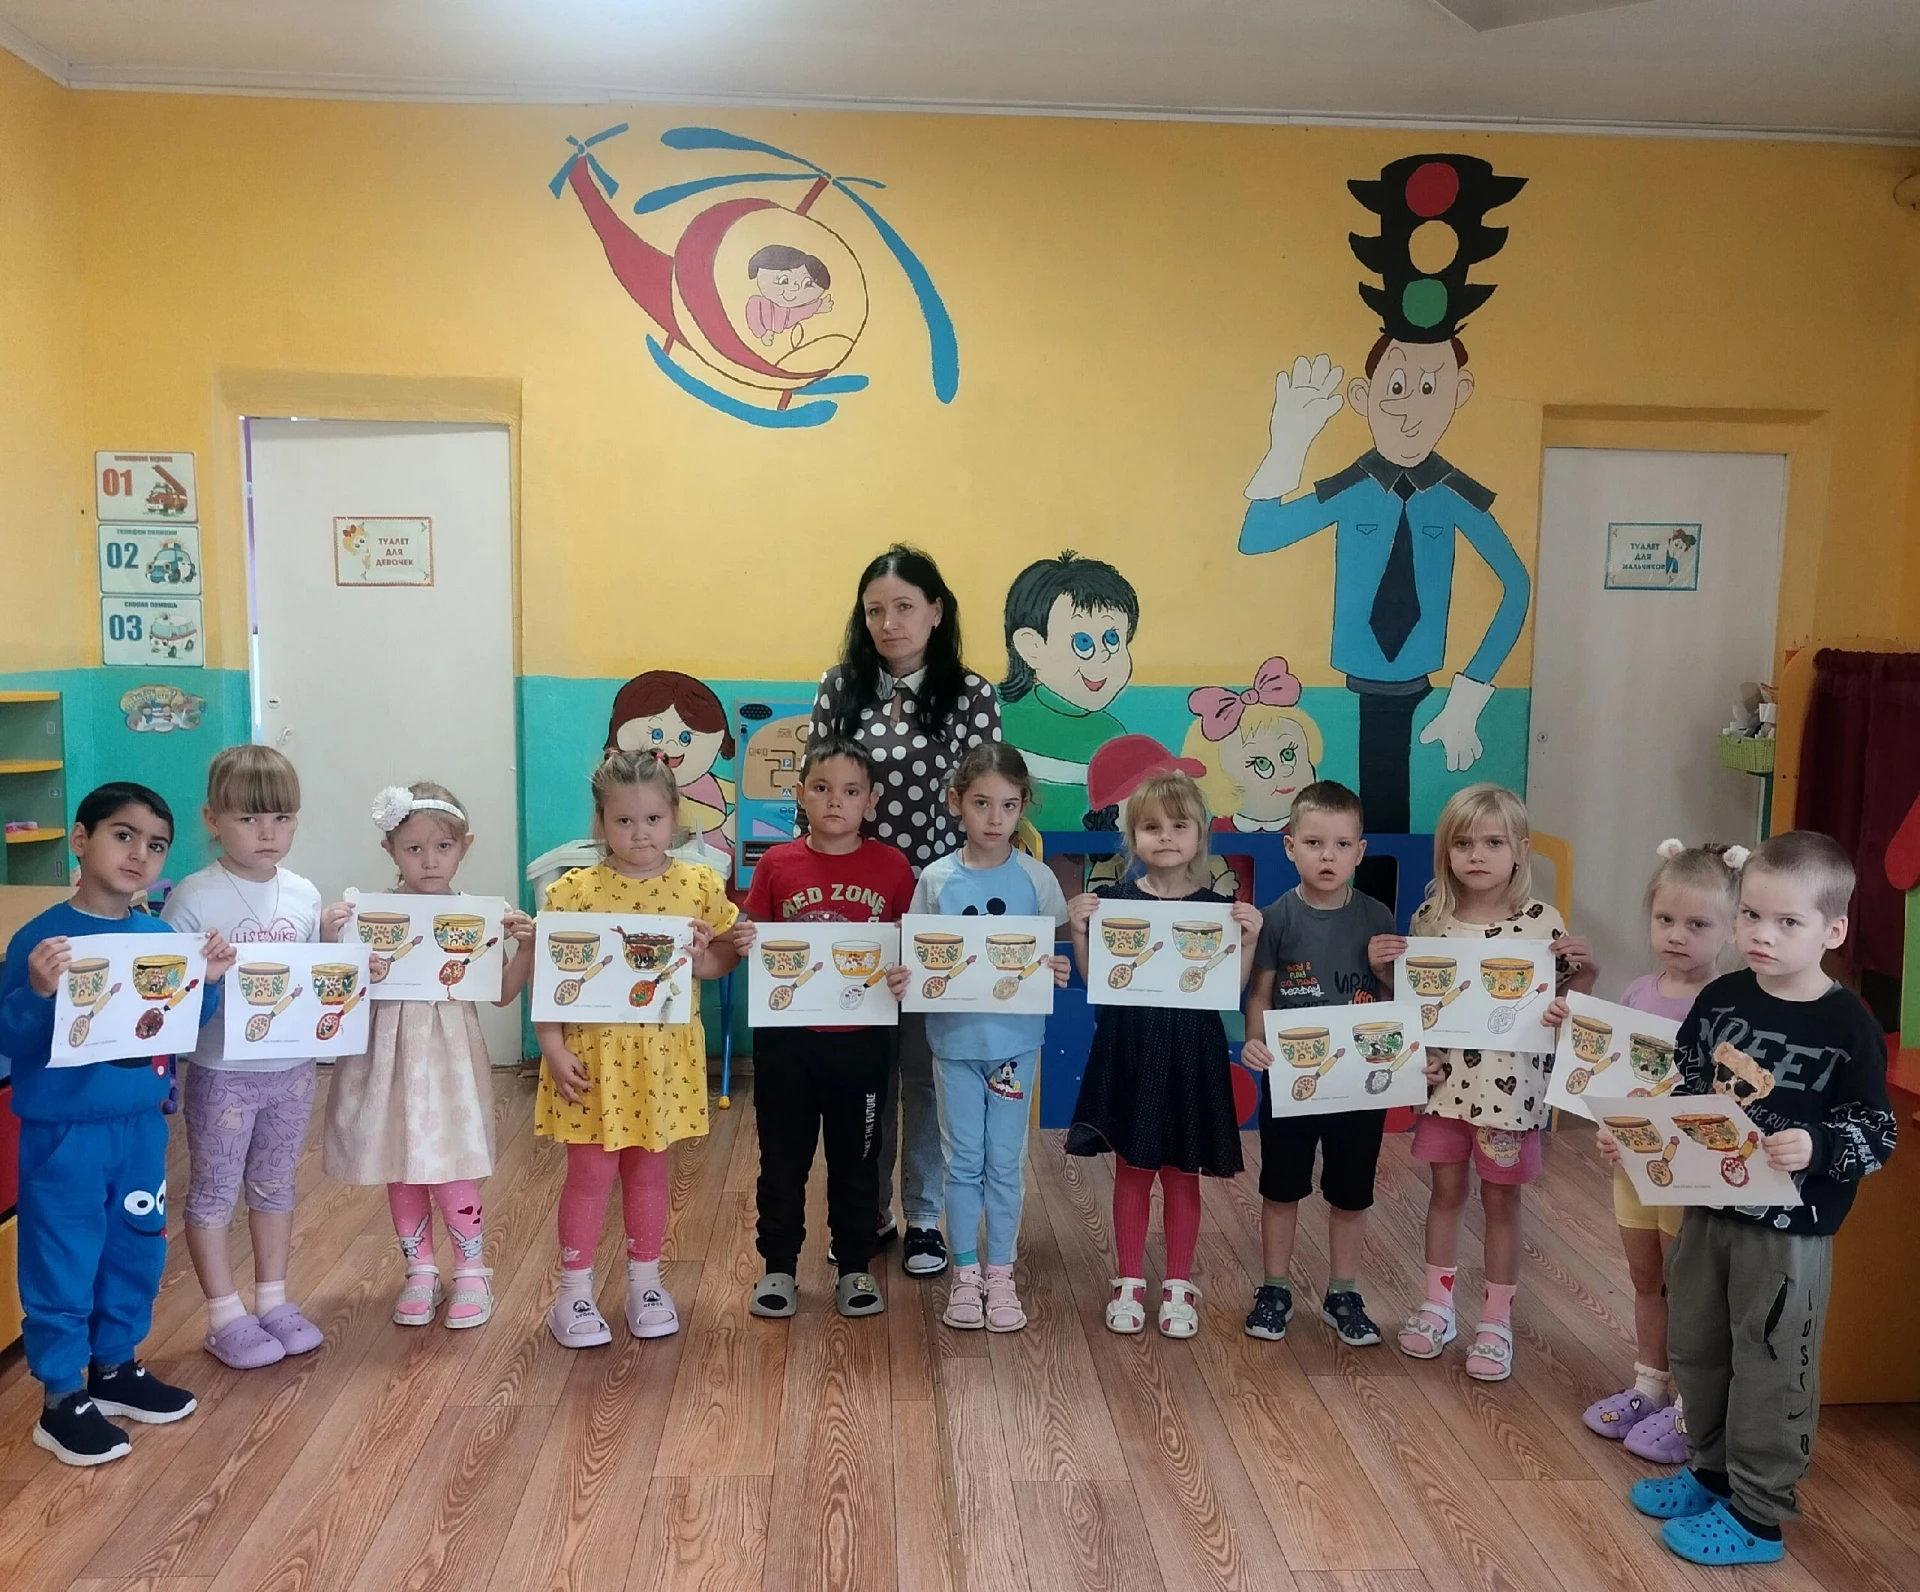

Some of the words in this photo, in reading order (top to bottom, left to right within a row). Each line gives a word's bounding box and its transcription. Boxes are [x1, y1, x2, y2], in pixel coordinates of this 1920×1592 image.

[102, 468, 132, 496] 01
[107, 542, 139, 569] 02
[386, 548, 403, 556] ДЛЯ
[1634, 553, 1652, 561] ДЛЯ
[376, 559, 413, 567] ДЕВОЧЕК
[109, 614, 142, 641] 03
[782, 887, 823, 918] RED
[831, 883, 886, 916] ZONE
[865, 1092, 876, 1123] FUTURE
[1745, 1105, 1768, 1121] HE
[575, 1311, 596, 1319] crocs
